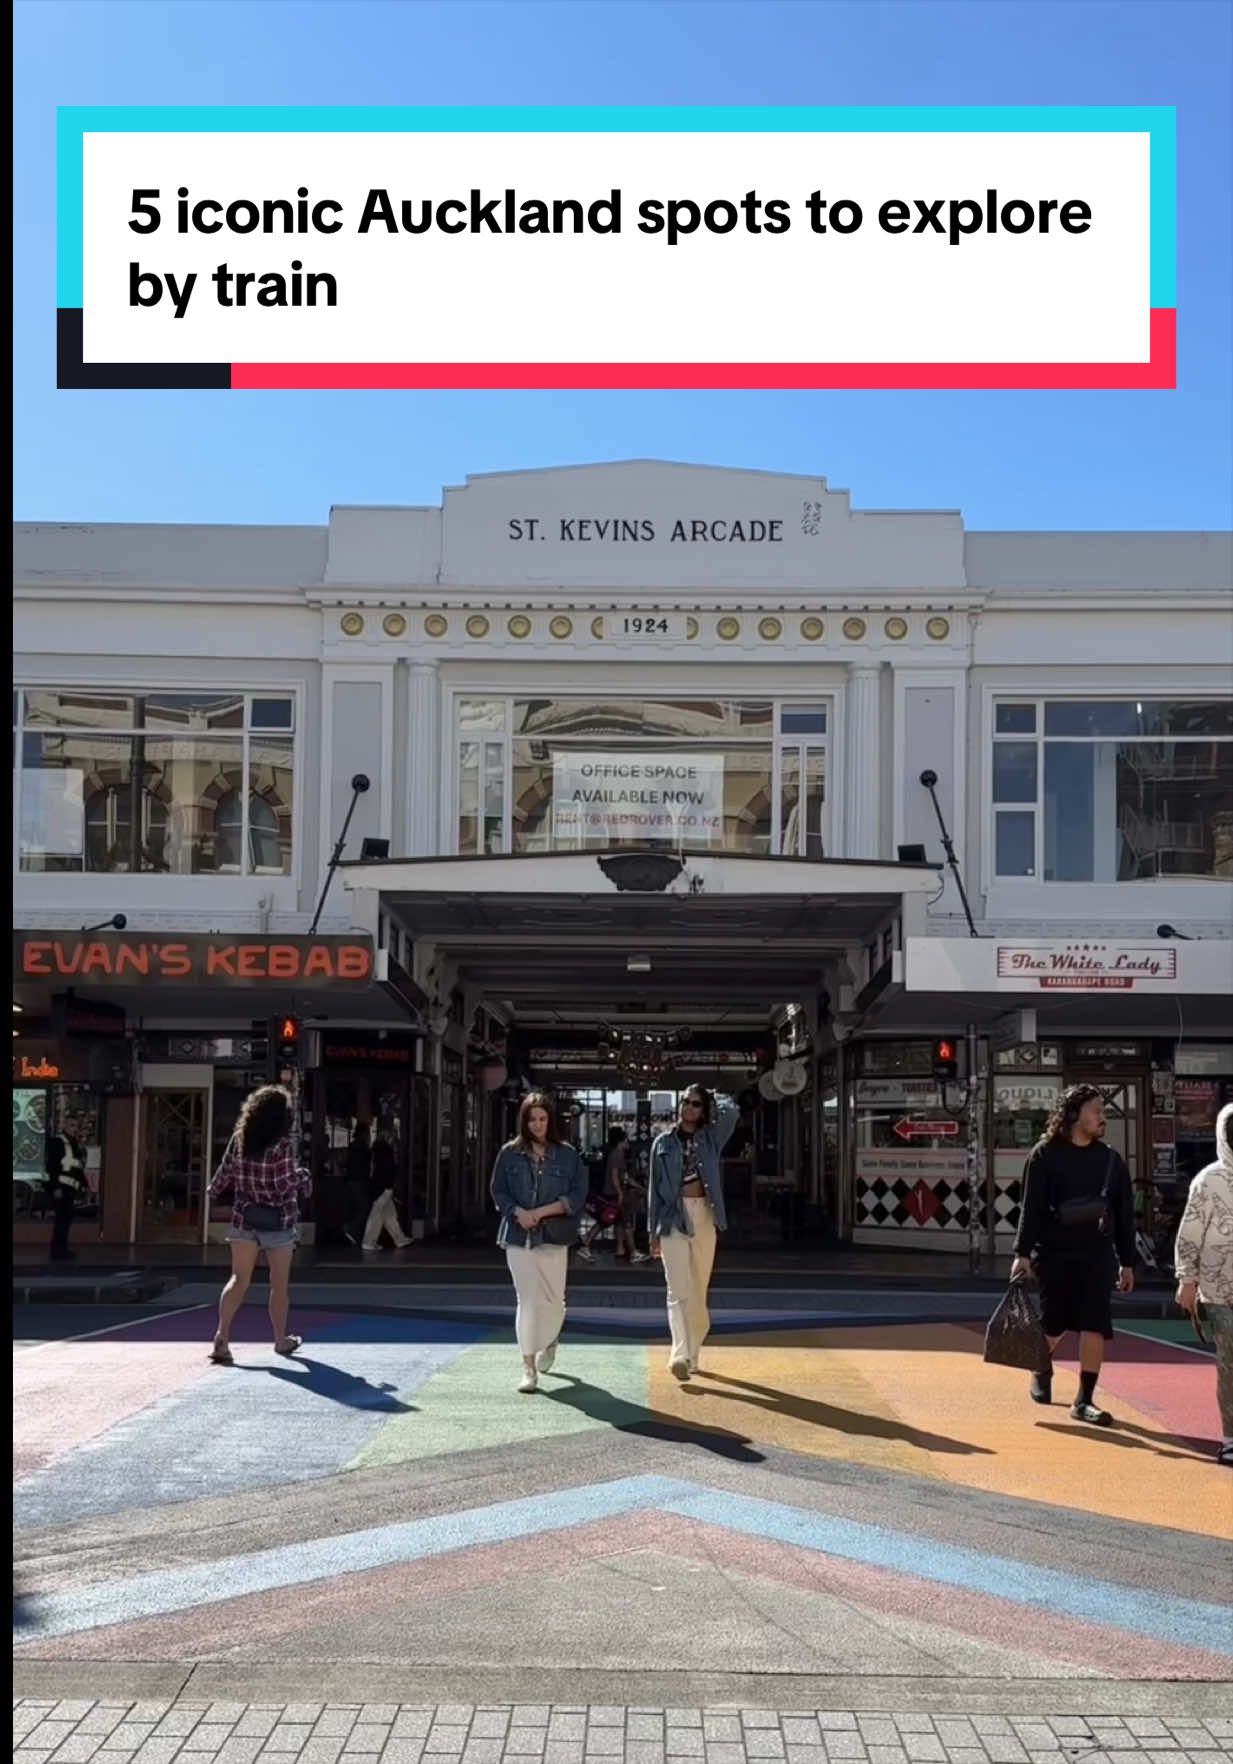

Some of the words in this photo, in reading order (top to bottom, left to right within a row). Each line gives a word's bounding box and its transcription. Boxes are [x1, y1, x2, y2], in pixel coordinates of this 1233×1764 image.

[509, 520, 546, 541] ST.
[560, 519, 655, 542] KEVINS
[670, 520, 783, 542] ARCADE
[624, 618, 668, 633] 1924
[581, 764, 640, 779] OFFICE
[644, 765, 697, 780] SPACE
[572, 789, 658, 804] AVAILABLE
[662, 790, 704, 805] NOW
[23, 942, 192, 976] EVAN'S
[206, 945, 370, 978] KEBAB
[1012, 953, 1047, 969] The
[1050, 953, 1105, 970] White
[1108, 954, 1162, 975] Lady
